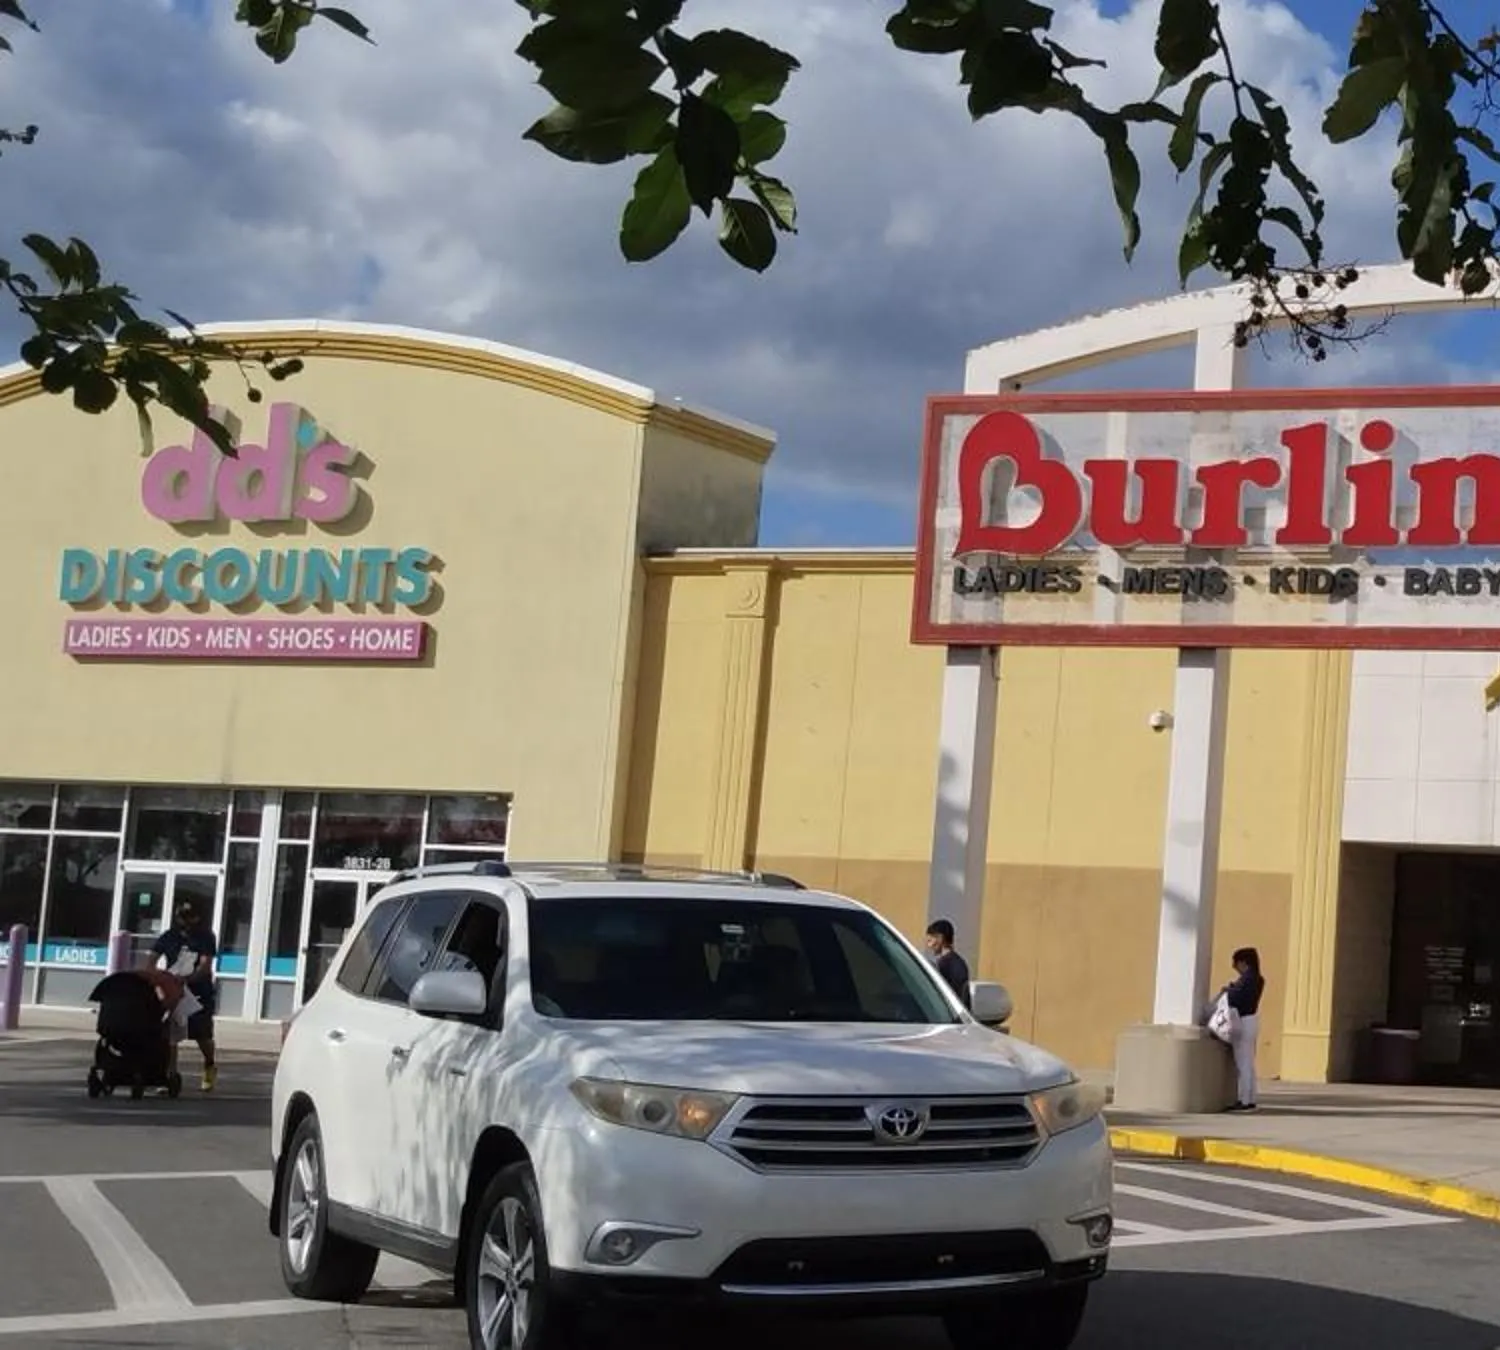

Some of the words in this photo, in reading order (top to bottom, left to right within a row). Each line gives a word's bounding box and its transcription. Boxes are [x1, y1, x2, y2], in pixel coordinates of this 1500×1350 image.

[141, 402, 362, 522] dd's
[59, 546, 436, 606] DISCOUNTS
[952, 566, 1082, 596] LADIES
[1121, 566, 1229, 598] MENS
[1268, 566, 1360, 598] KIDS
[67, 625, 132, 649] LADIES
[146, 626, 191, 649] KIDS
[205, 627, 251, 649] MEN
[267, 627, 335, 650] SHOES
[350, 628, 414, 651] HOME
[55, 946, 97, 964] LADIES
